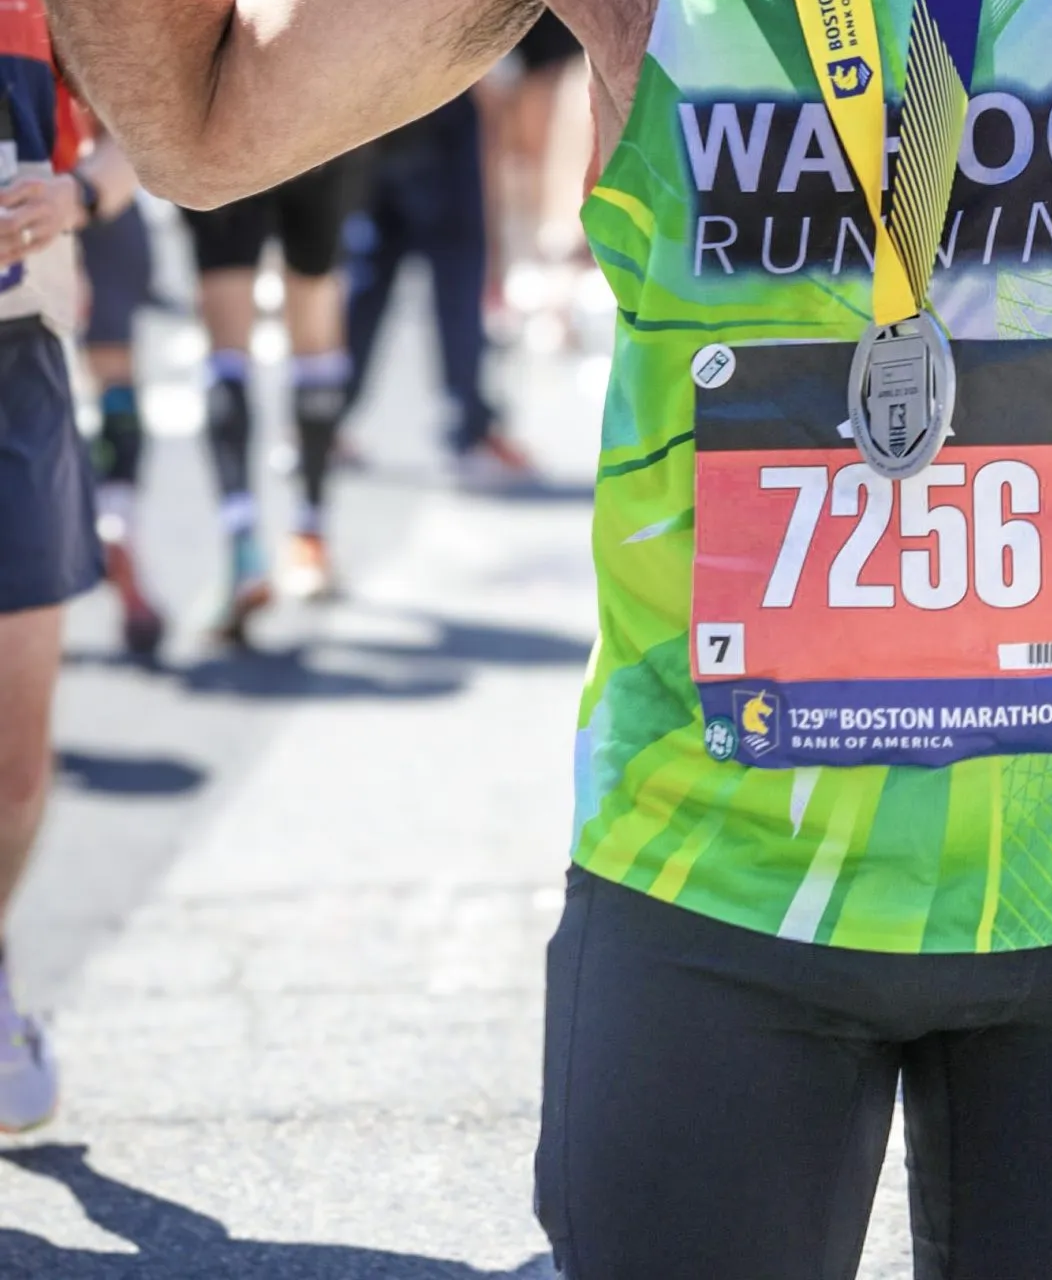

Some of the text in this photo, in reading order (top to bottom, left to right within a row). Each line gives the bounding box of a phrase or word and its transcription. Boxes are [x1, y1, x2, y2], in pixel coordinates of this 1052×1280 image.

[843, 9, 858, 47] BANK
[759, 460, 1043, 611] 7256
[709, 635, 731, 664] 7
[840, 707, 934, 730] BOSTON
[791, 736, 954, 749] BANK OF AMERICA
